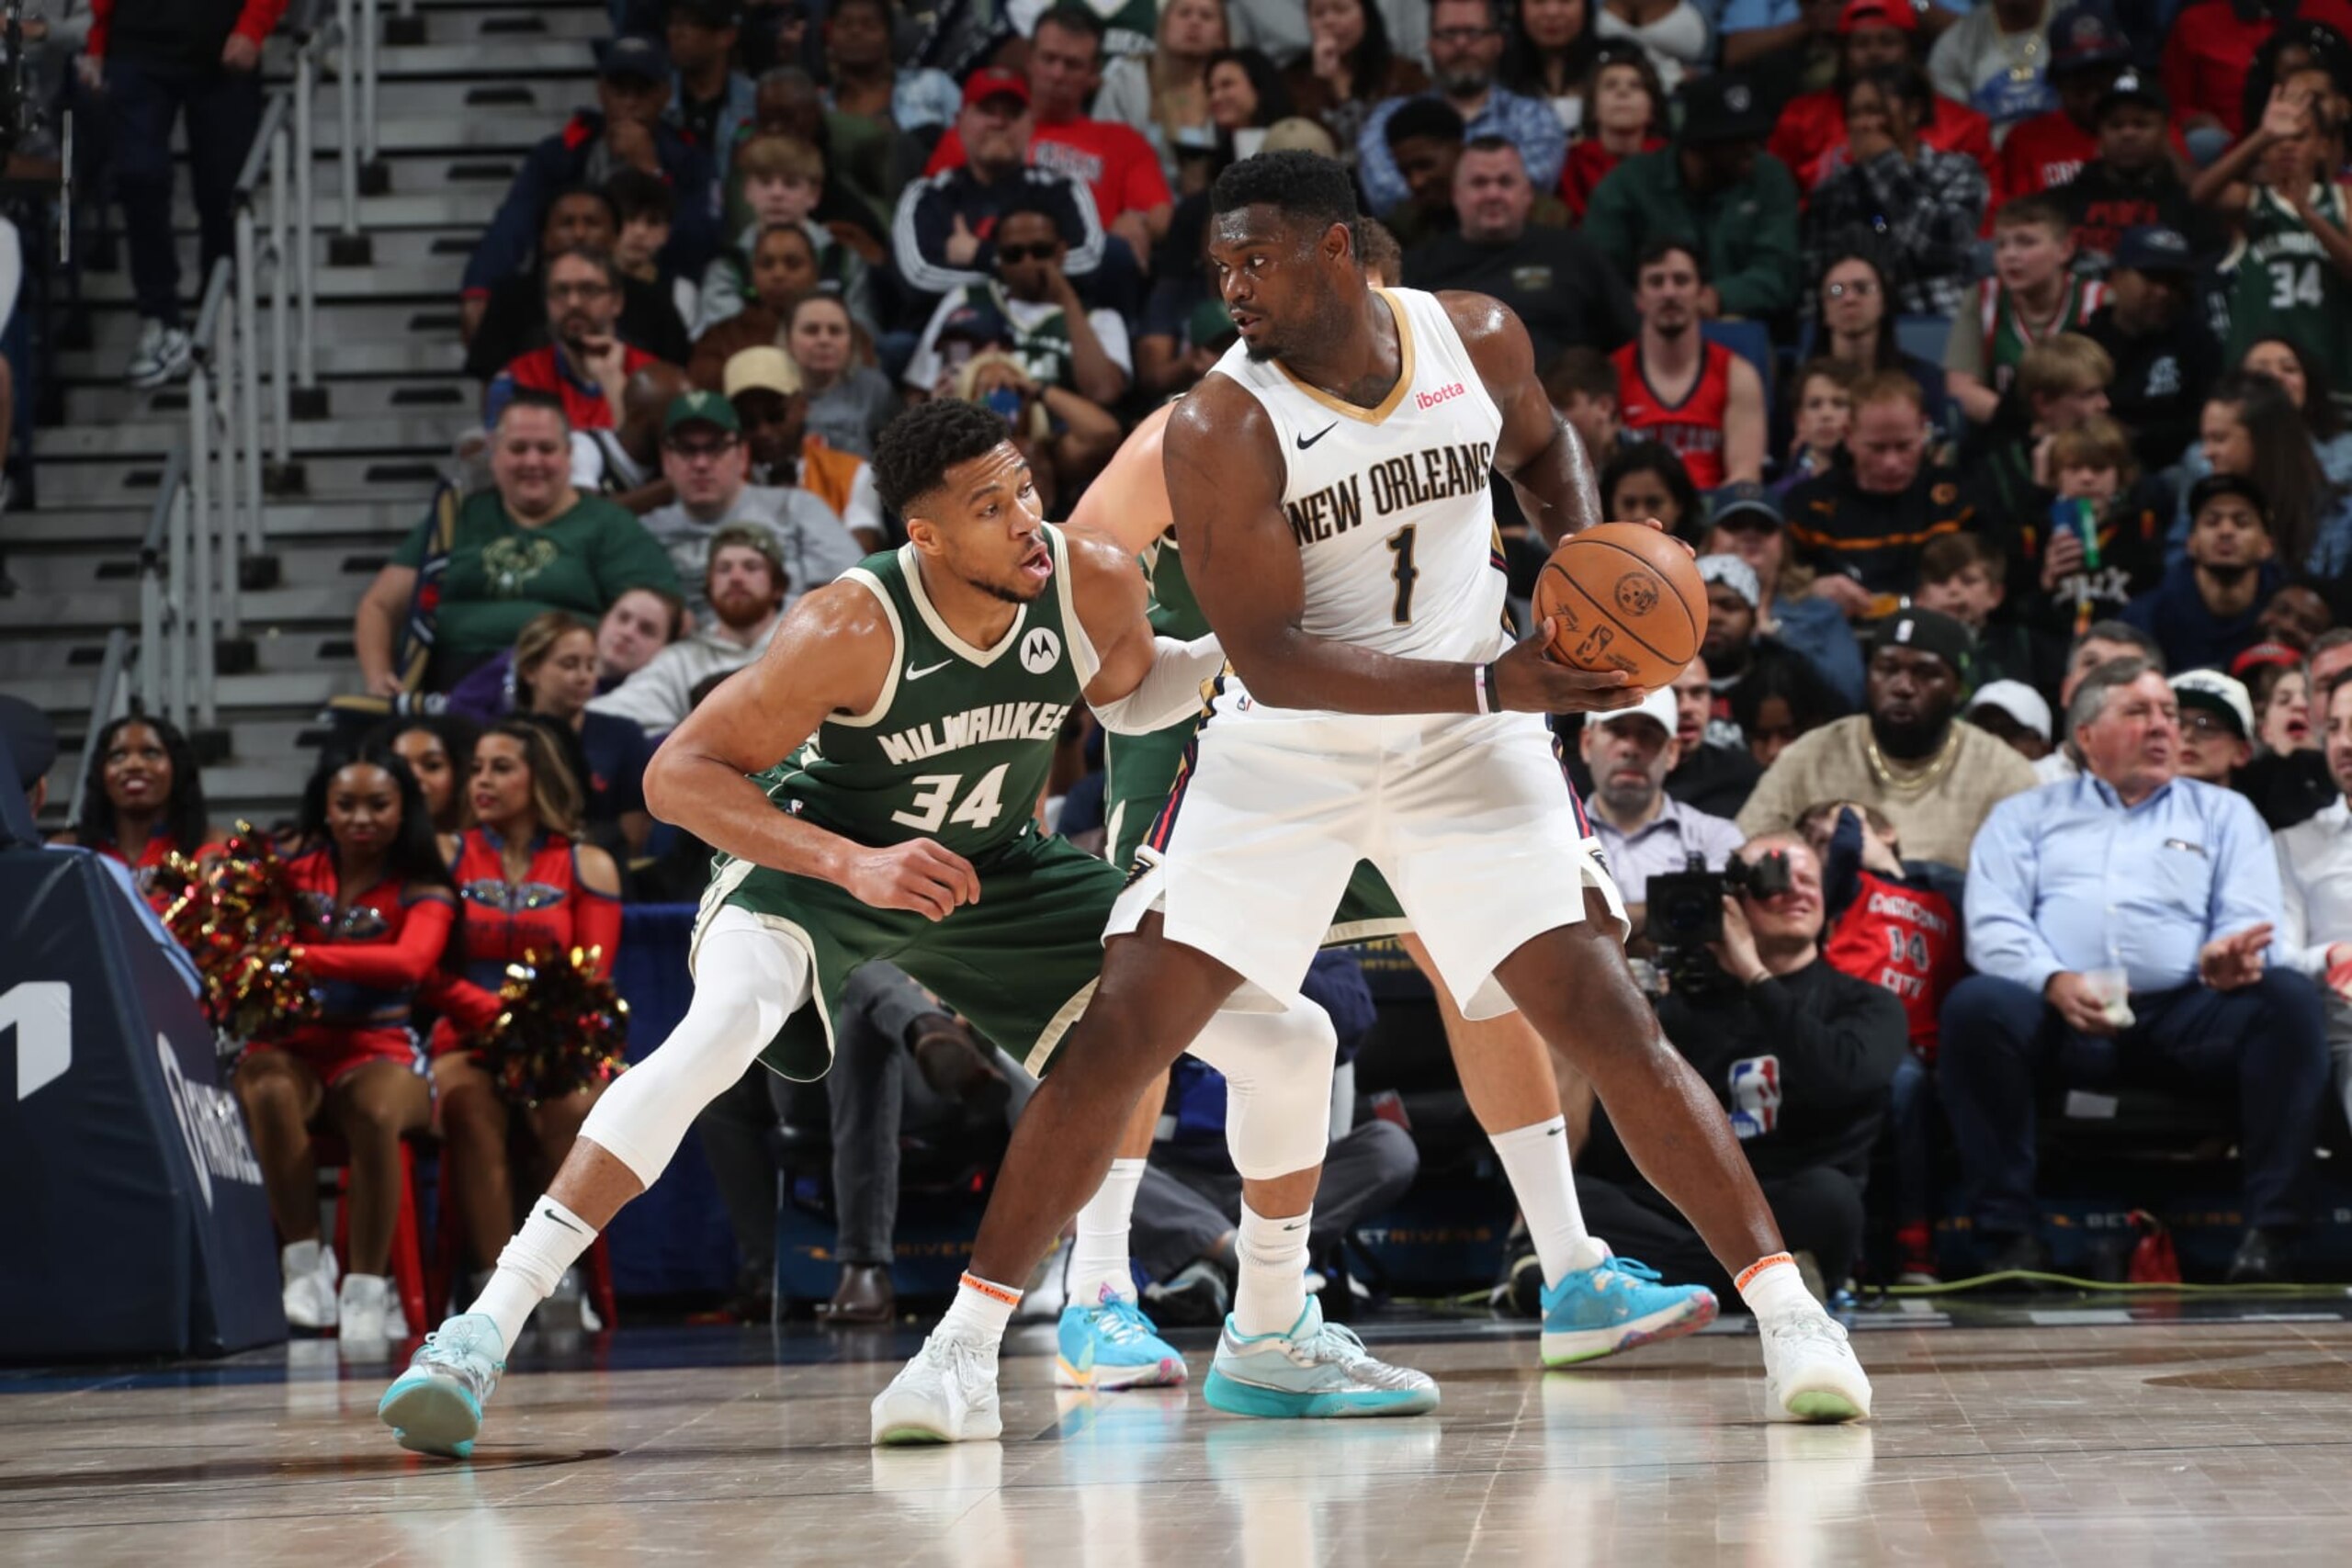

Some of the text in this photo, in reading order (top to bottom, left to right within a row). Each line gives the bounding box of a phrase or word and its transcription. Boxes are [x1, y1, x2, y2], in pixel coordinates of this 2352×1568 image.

[2267, 261, 2324, 309] 34
[1416, 381, 1465, 411] ibotta
[1287, 441, 1491, 547] NEW ORLEANS
[1385, 523, 1420, 626] 1
[877, 701, 1072, 766] MILWAUKEE
[890, 762, 1011, 833] 34
[1885, 925, 1929, 973] 14
